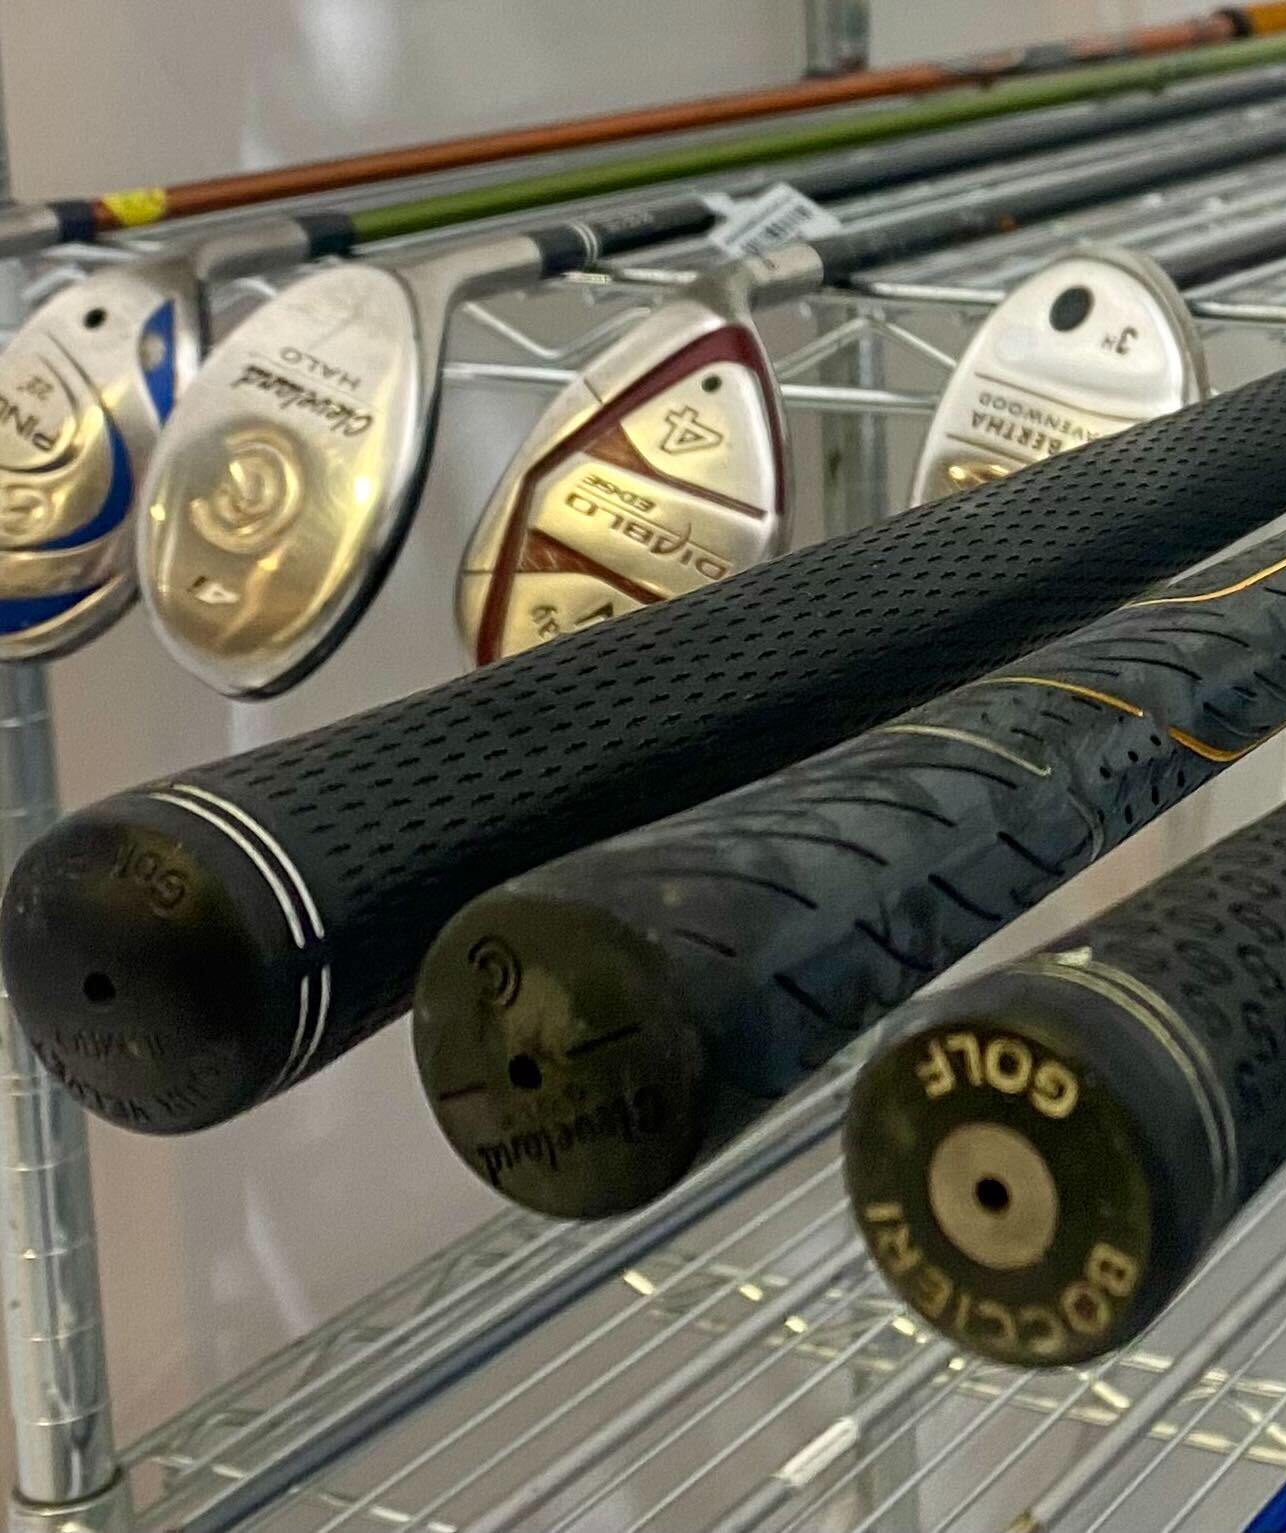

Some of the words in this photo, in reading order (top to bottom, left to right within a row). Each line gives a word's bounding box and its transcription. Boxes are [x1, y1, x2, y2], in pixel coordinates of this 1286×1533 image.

[281, 346, 361, 390] HALO
[231, 364, 373, 437] Cleveland
[979, 391, 1101, 443] AVENWOOD
[660, 405, 724, 455] 4
[972, 410, 1064, 455] BERTHA
[582, 474, 656, 513] EDGE
[565, 492, 728, 581] DIABLO
[916, 1032, 1080, 1119] GOLF
[864, 1201, 1138, 1357] BOCCIERI
